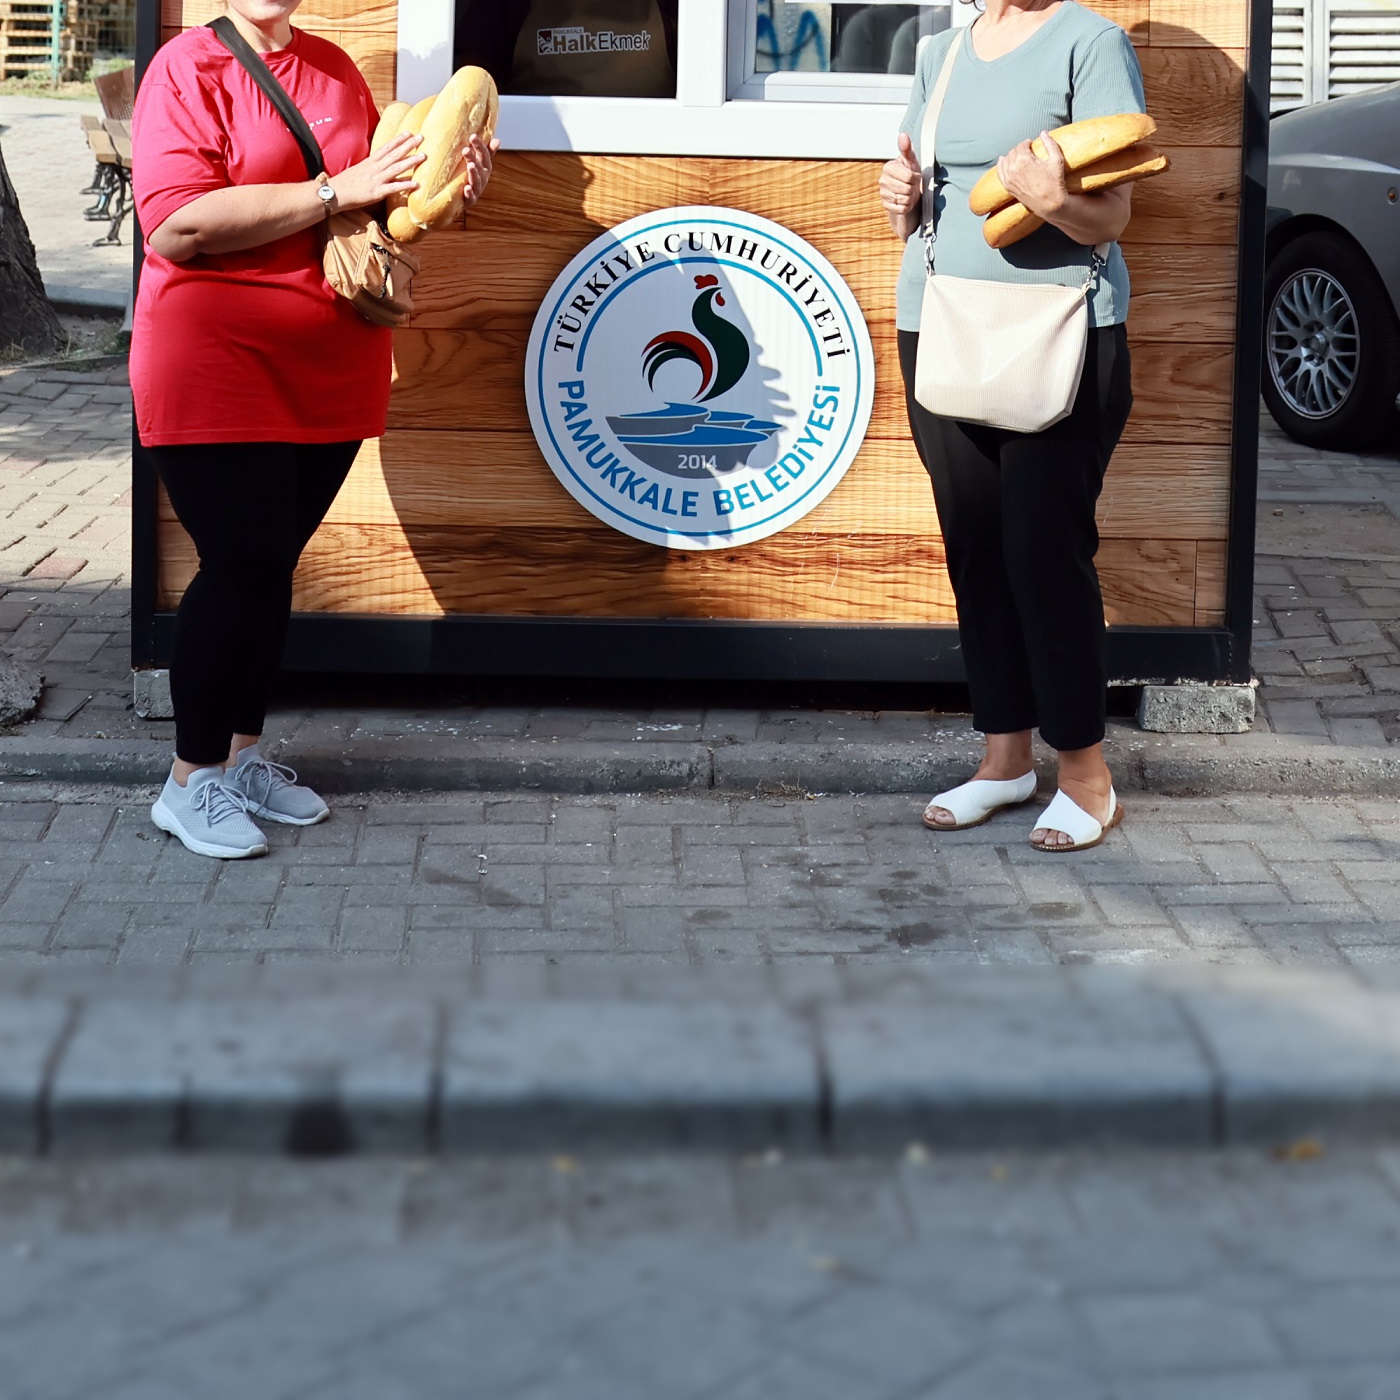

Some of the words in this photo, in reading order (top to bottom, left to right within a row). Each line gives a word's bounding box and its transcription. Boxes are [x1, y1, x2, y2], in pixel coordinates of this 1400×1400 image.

[553, 241, 656, 353] TÜRKİYE
[663, 231, 851, 360] CUMHURİYETİ
[557, 379, 700, 518] PAMUKKALE
[677, 454, 718, 470] 2014
